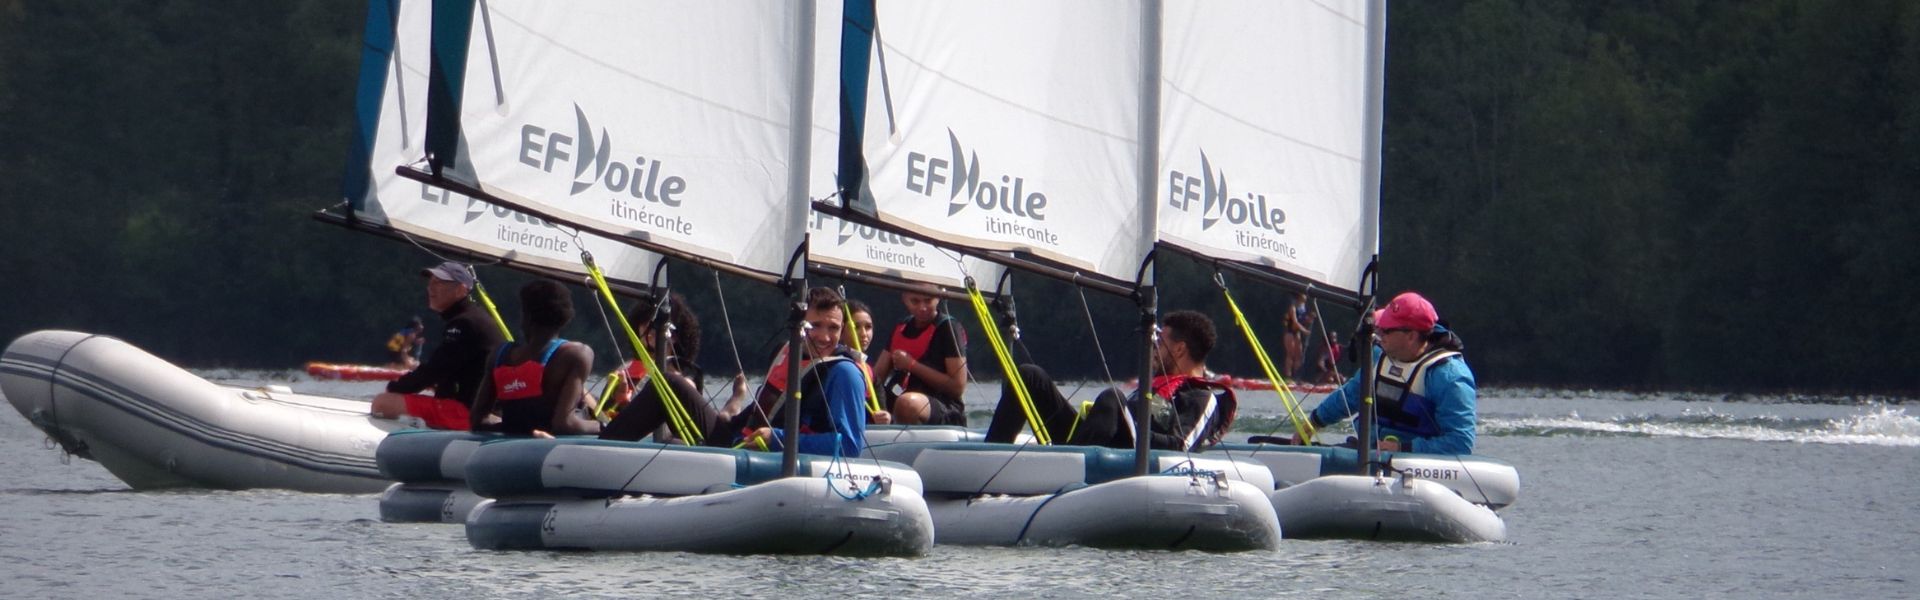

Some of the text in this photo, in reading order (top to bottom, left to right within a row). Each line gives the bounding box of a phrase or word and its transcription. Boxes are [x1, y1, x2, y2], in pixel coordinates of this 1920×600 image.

[611, 199, 693, 236] itinérante
[986, 216, 1059, 246] itinérante
[497, 224, 568, 253] itinérante
[1236, 230, 1297, 259] itinérante
[866, 245, 925, 268] itinérante
